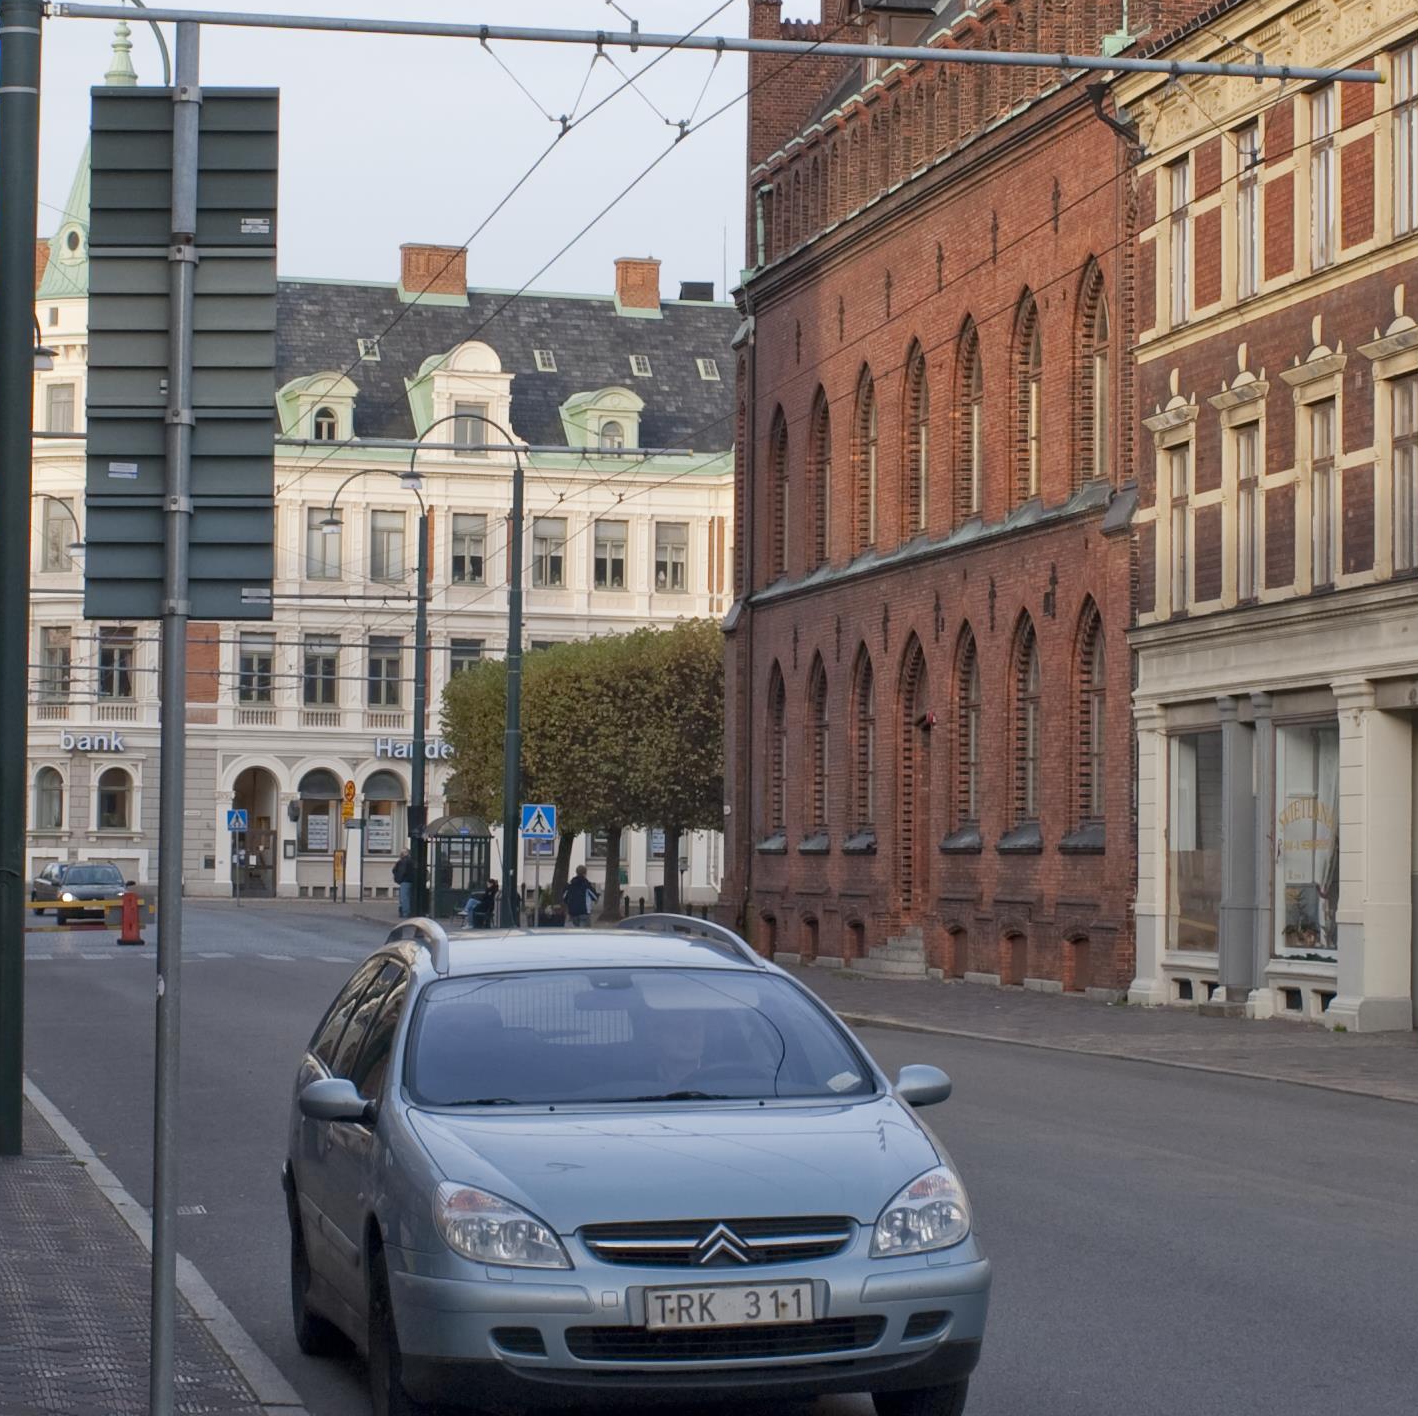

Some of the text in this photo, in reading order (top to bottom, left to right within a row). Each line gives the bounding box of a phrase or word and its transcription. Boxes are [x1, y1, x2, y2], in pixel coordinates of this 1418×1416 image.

[60, 728, 125, 752] bank
[654, 1287, 802, 1324] TRK 311
